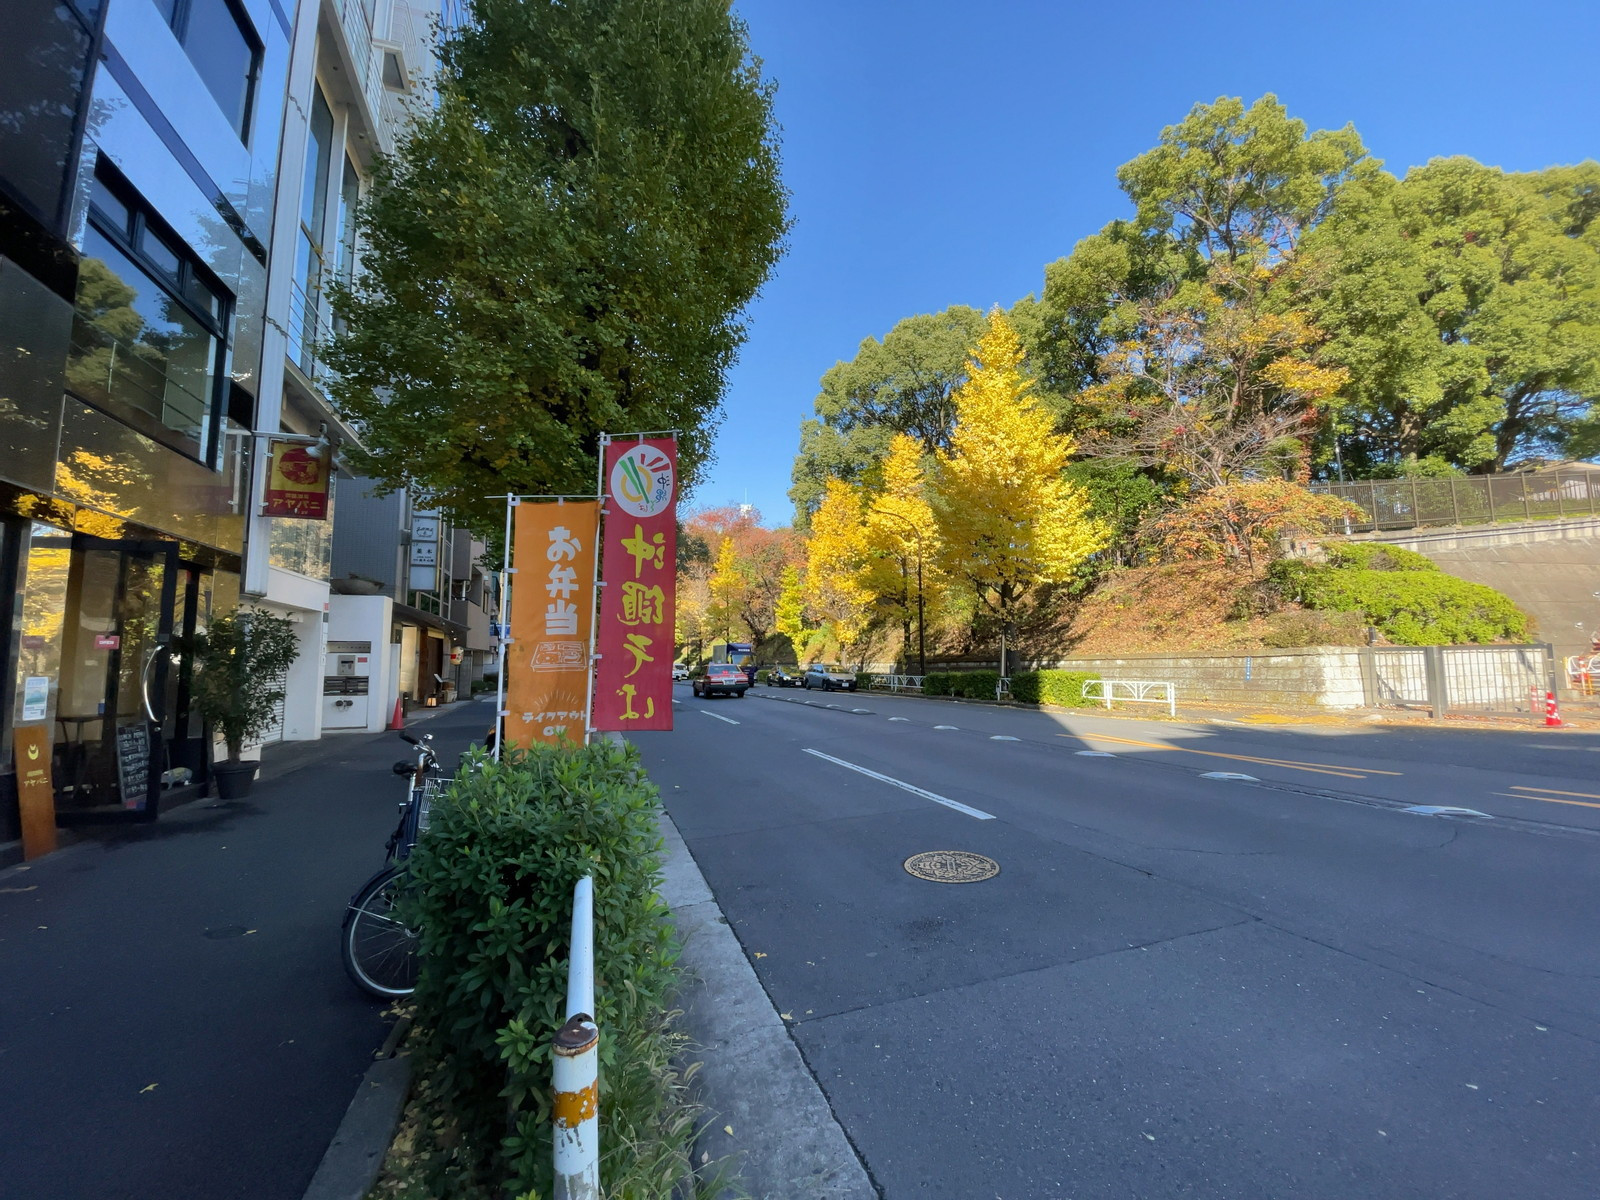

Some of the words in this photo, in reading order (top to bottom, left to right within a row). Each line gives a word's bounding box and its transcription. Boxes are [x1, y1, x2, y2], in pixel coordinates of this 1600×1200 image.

[545, 526, 582, 636] お弁当
[522, 711, 586, 724] テイクアウト
